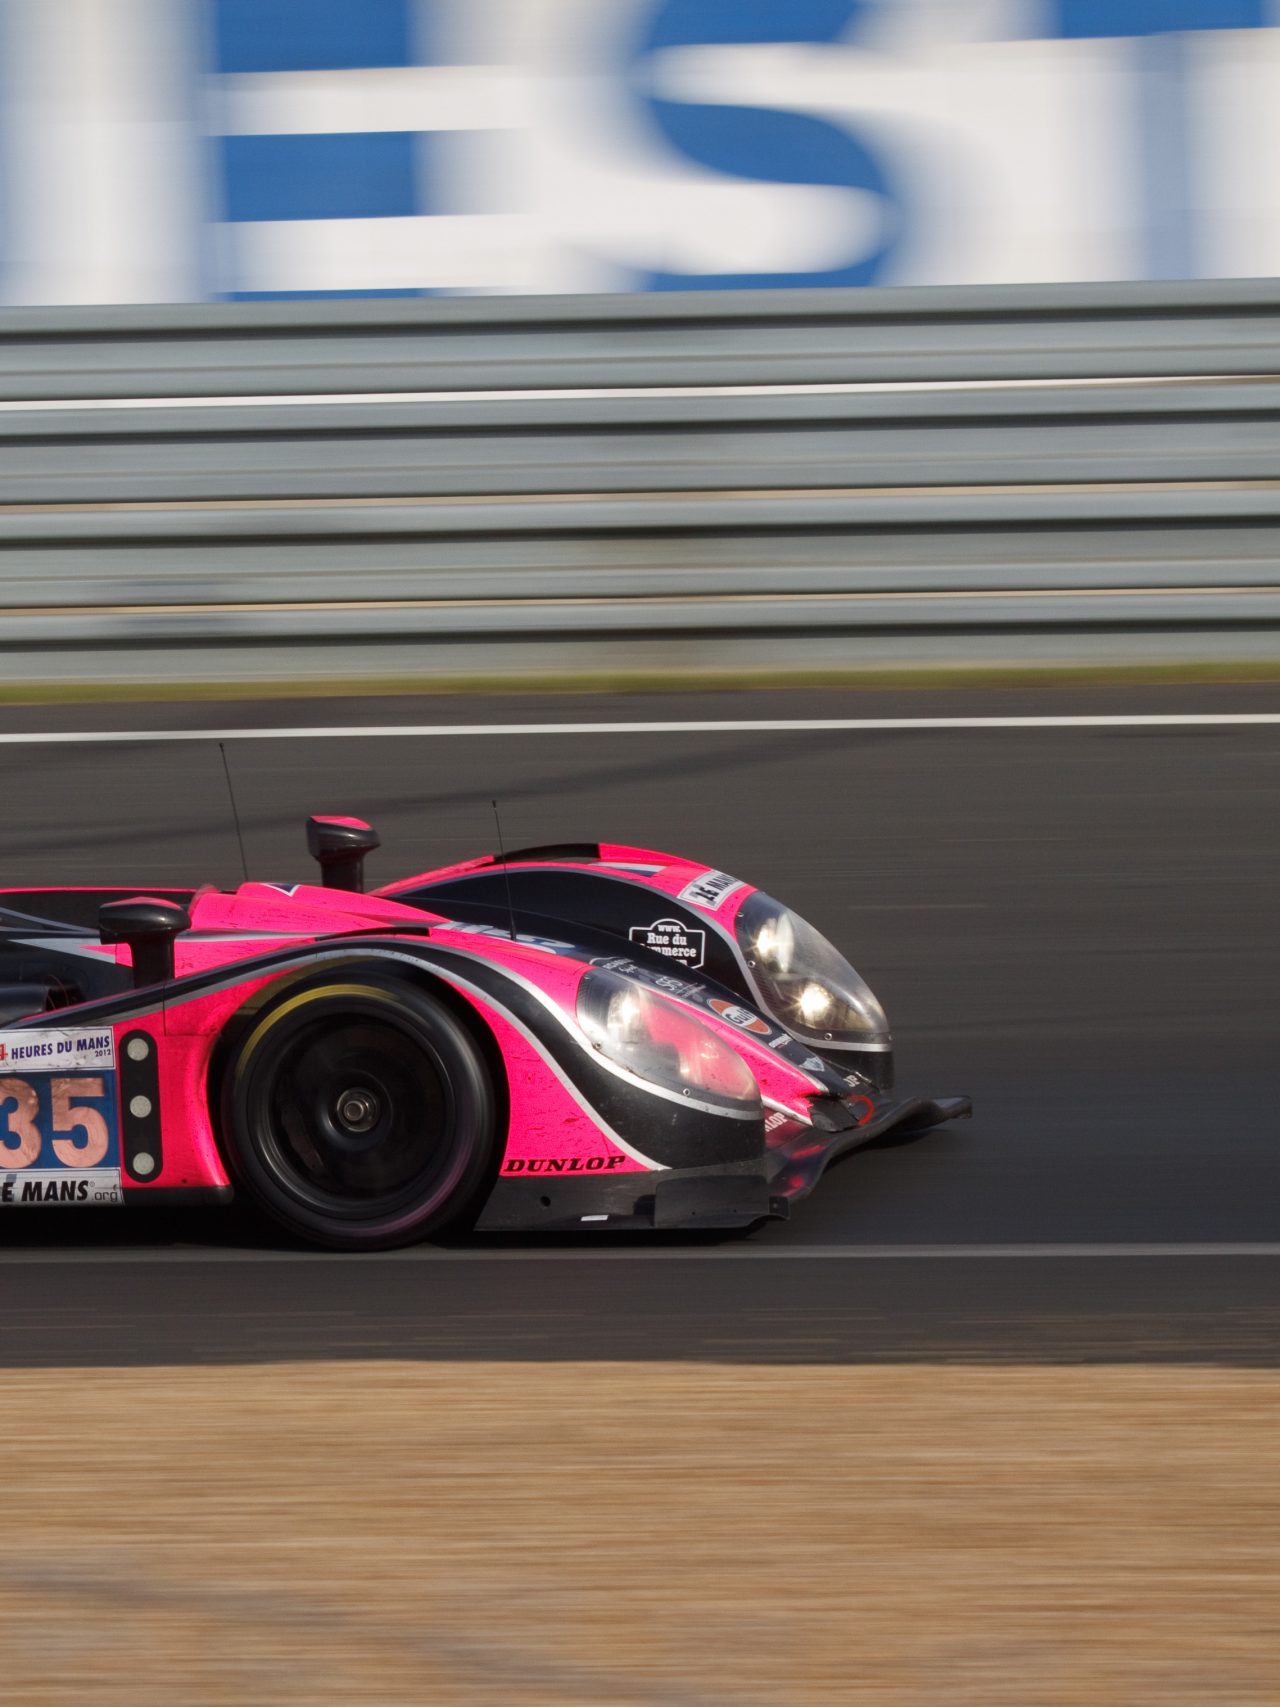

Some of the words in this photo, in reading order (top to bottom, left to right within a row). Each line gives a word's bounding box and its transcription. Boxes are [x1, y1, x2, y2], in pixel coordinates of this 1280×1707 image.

[657, 924, 681, 933] www.
[647, 932, 670, 945] Rue
[672, 933, 688, 946] du
[11, 1043, 53, 1060] HEURES
[57, 1040, 73, 1054] DU
[76, 1035, 110, 1051] MANS
[94, 1049, 112, 1058] 2012
[504, 1156, 625, 1172] DUNLOP
[21, 1180, 89, 1202] MANS
